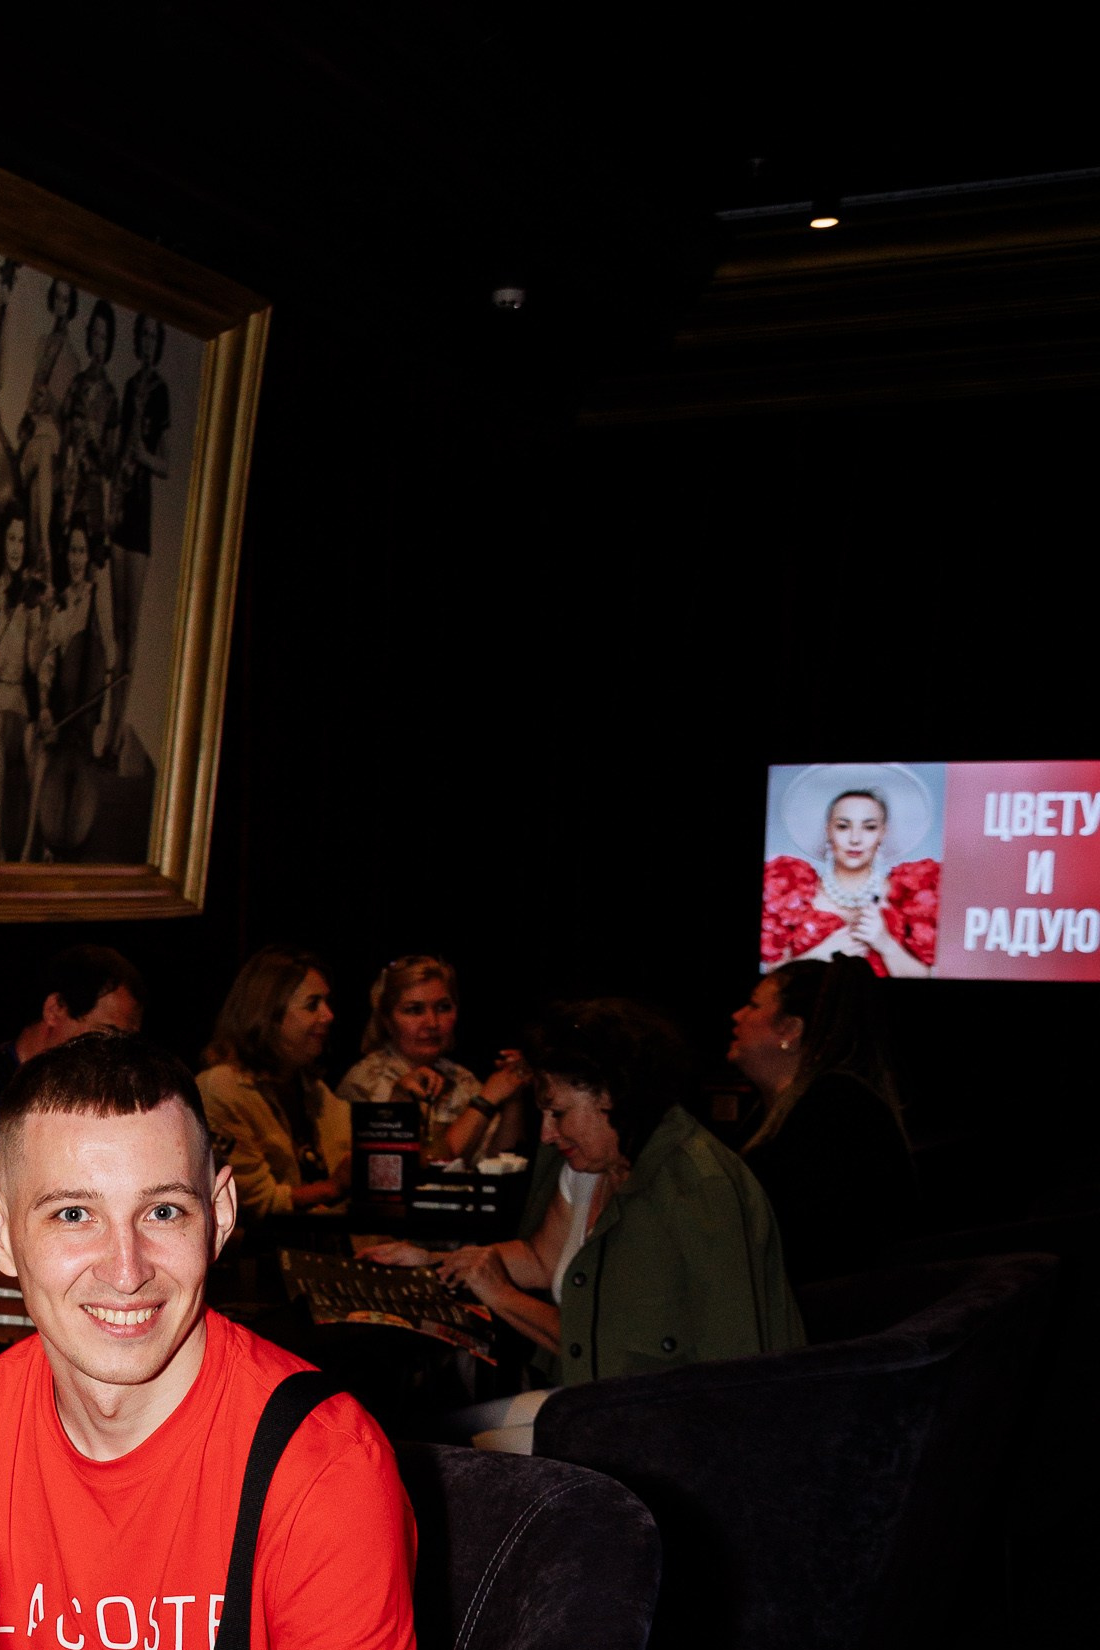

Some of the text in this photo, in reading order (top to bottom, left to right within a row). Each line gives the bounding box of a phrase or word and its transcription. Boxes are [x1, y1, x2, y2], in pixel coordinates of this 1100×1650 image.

[983, 790, 1100, 842] ЦВЕТУ
[1025, 849, 1056, 895] И
[963, 906, 1100, 958] РАДУЮ
